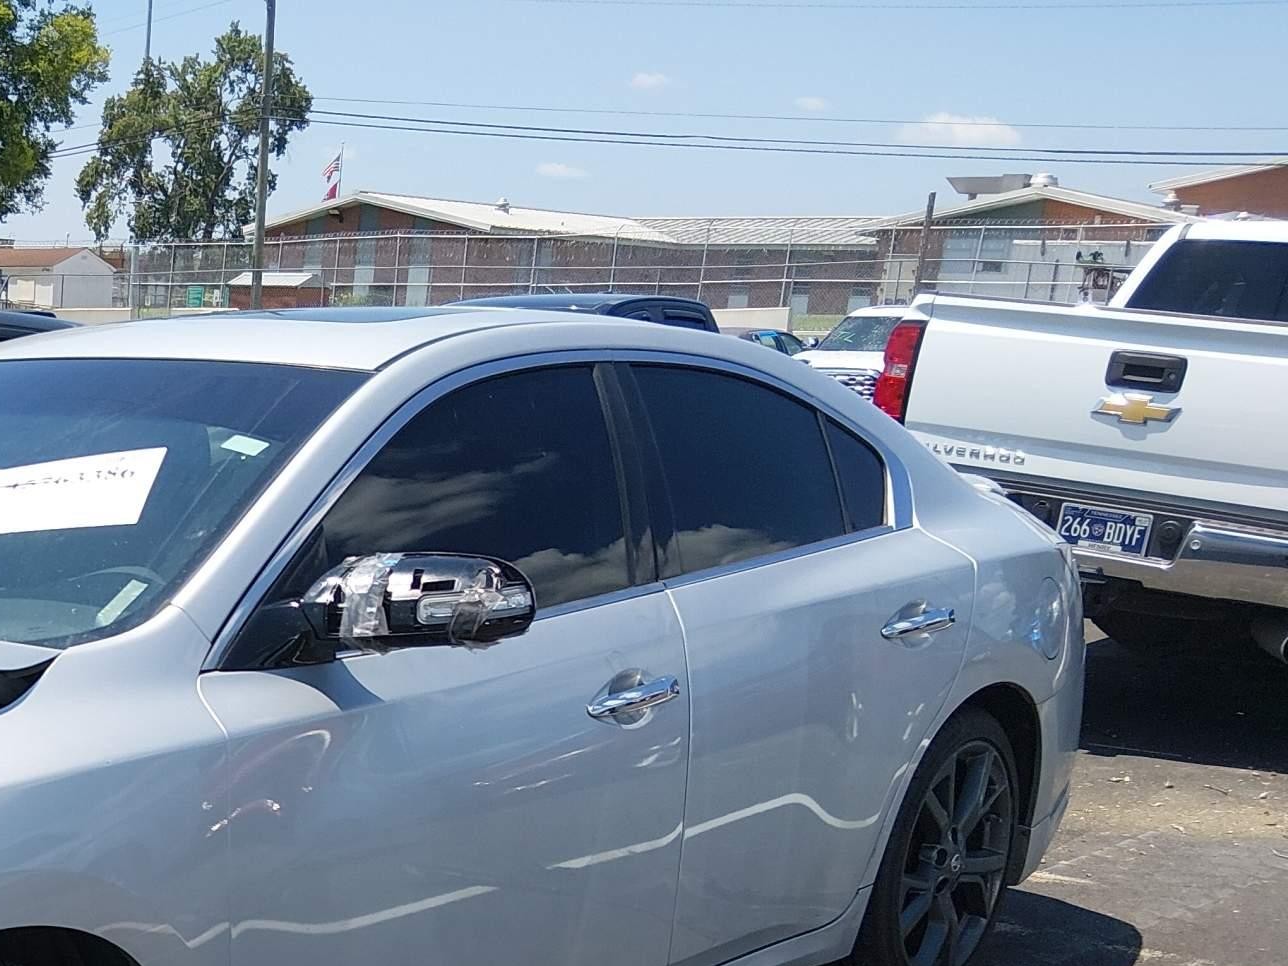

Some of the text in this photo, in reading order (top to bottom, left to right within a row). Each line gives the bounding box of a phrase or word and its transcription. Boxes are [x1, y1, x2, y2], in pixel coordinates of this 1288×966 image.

[925, 442, 1026, 466] LVERADO
[1060, 515, 1145, 546] 266 BDYF
